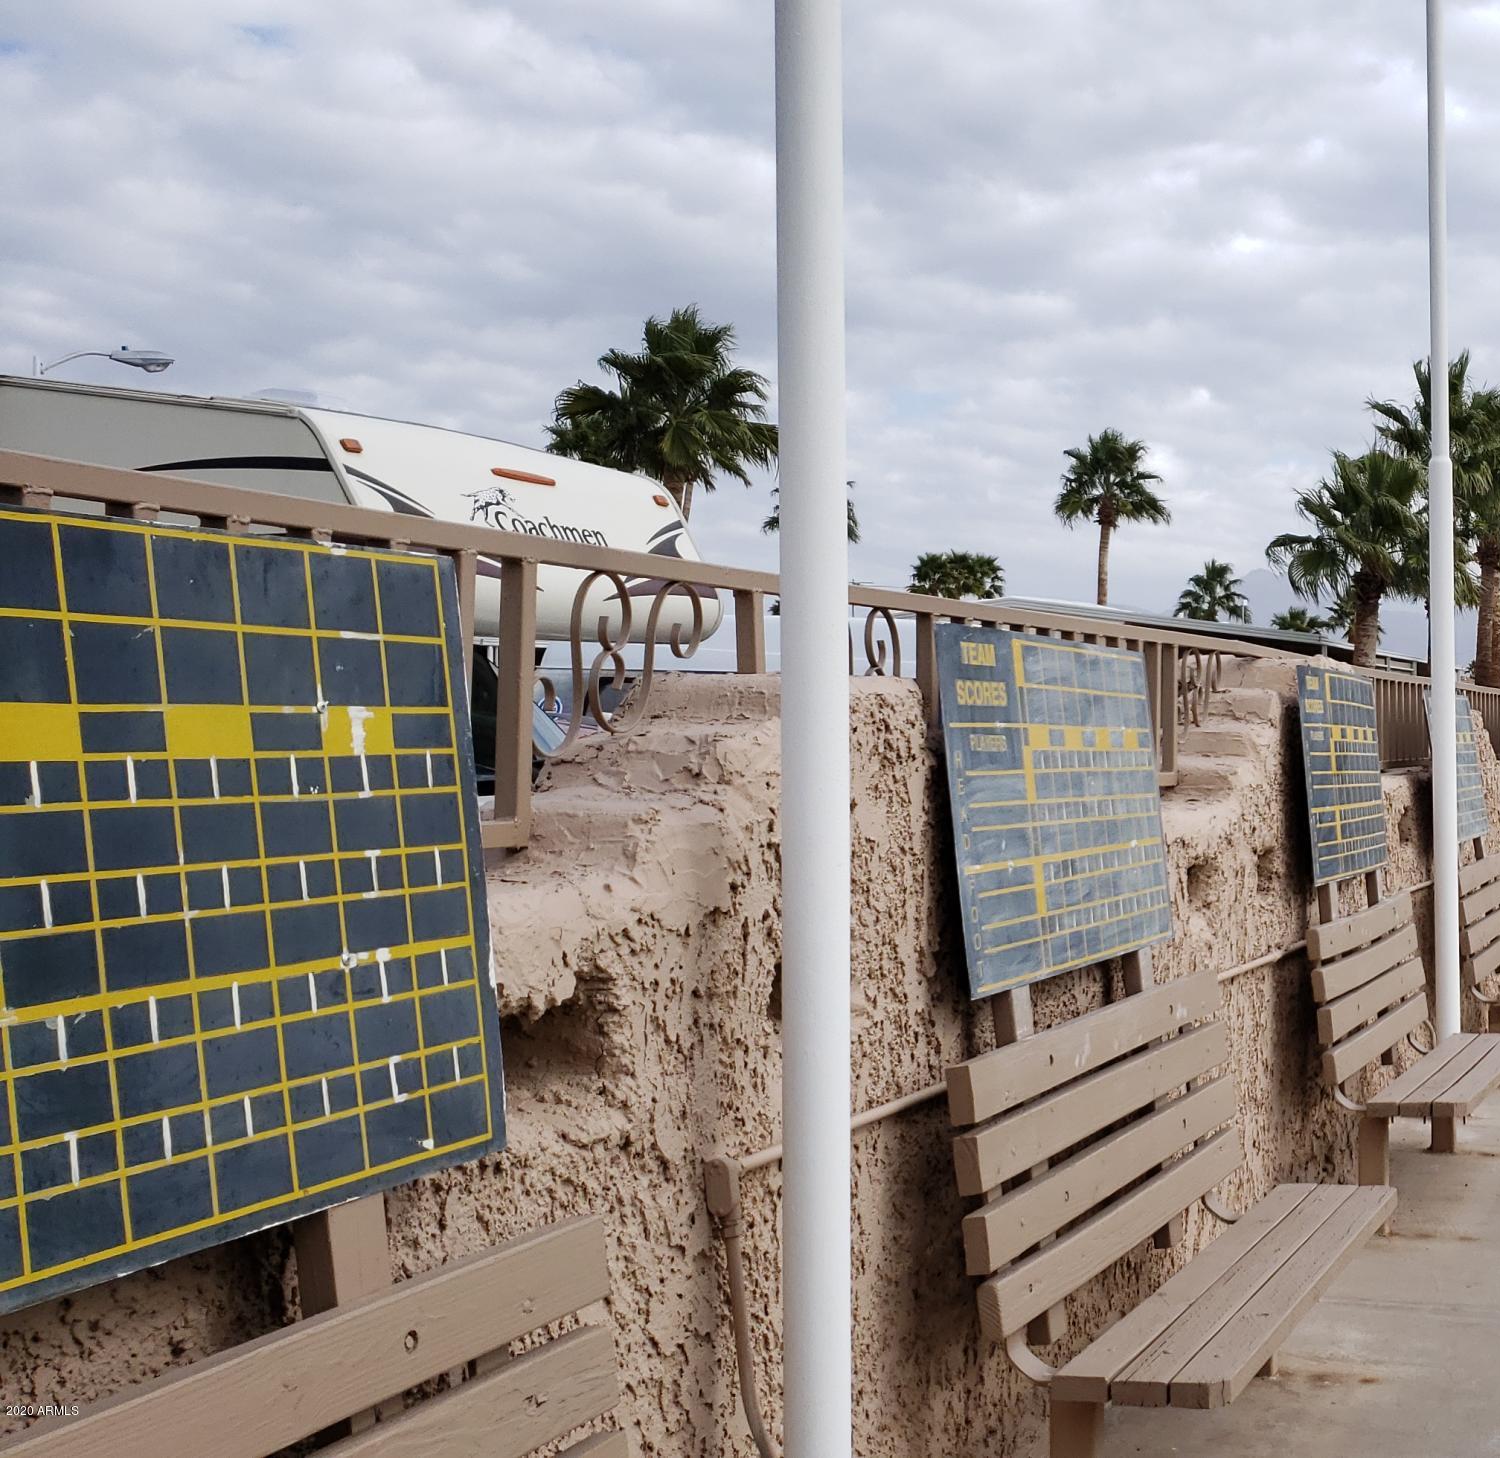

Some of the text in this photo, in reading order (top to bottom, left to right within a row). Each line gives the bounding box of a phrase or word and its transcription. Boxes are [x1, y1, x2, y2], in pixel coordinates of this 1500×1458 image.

[494, 510, 608, 547] Coachmen
[960, 641, 996, 667] TEAM
[955, 679, 1008, 707] SCORES
